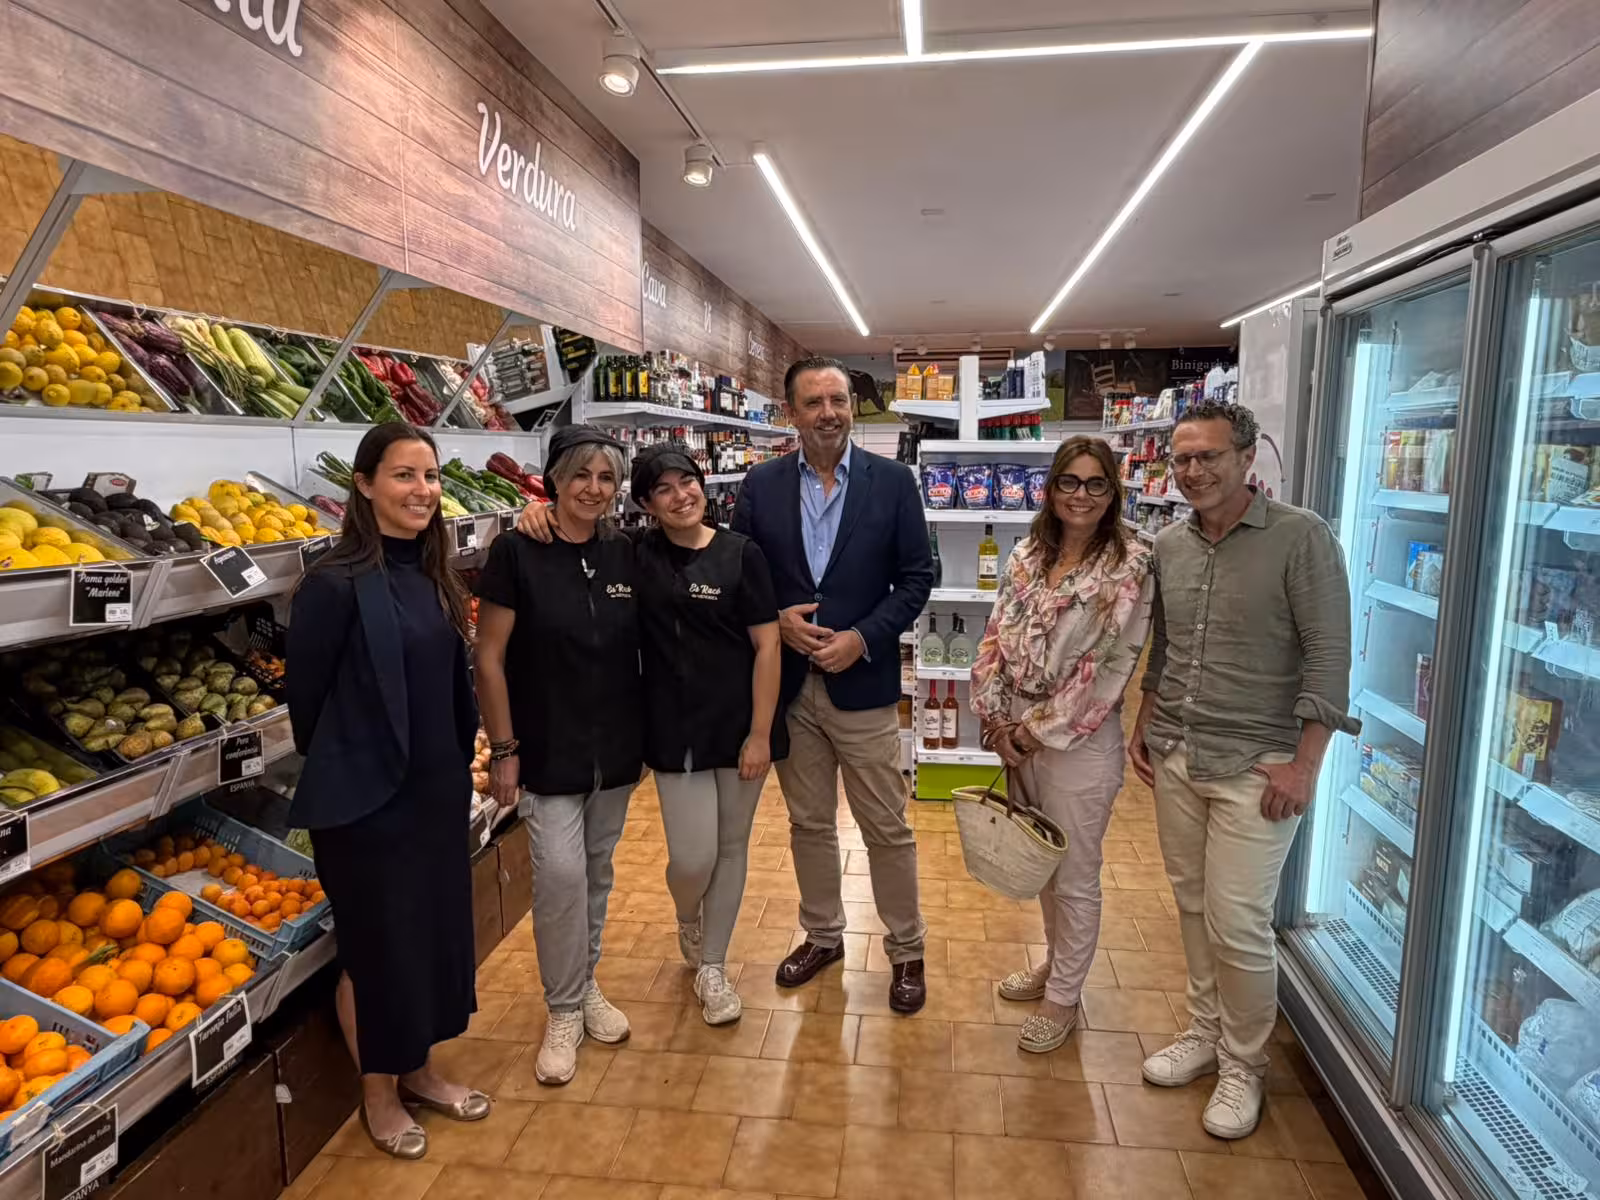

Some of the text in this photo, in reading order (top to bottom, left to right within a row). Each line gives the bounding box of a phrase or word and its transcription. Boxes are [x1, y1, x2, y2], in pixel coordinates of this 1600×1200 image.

[476, 102, 577, 232] Verdura
[641, 261, 667, 308] Cava
[79, 572, 103, 583] Poma
[689, 583, 700, 593] Es
